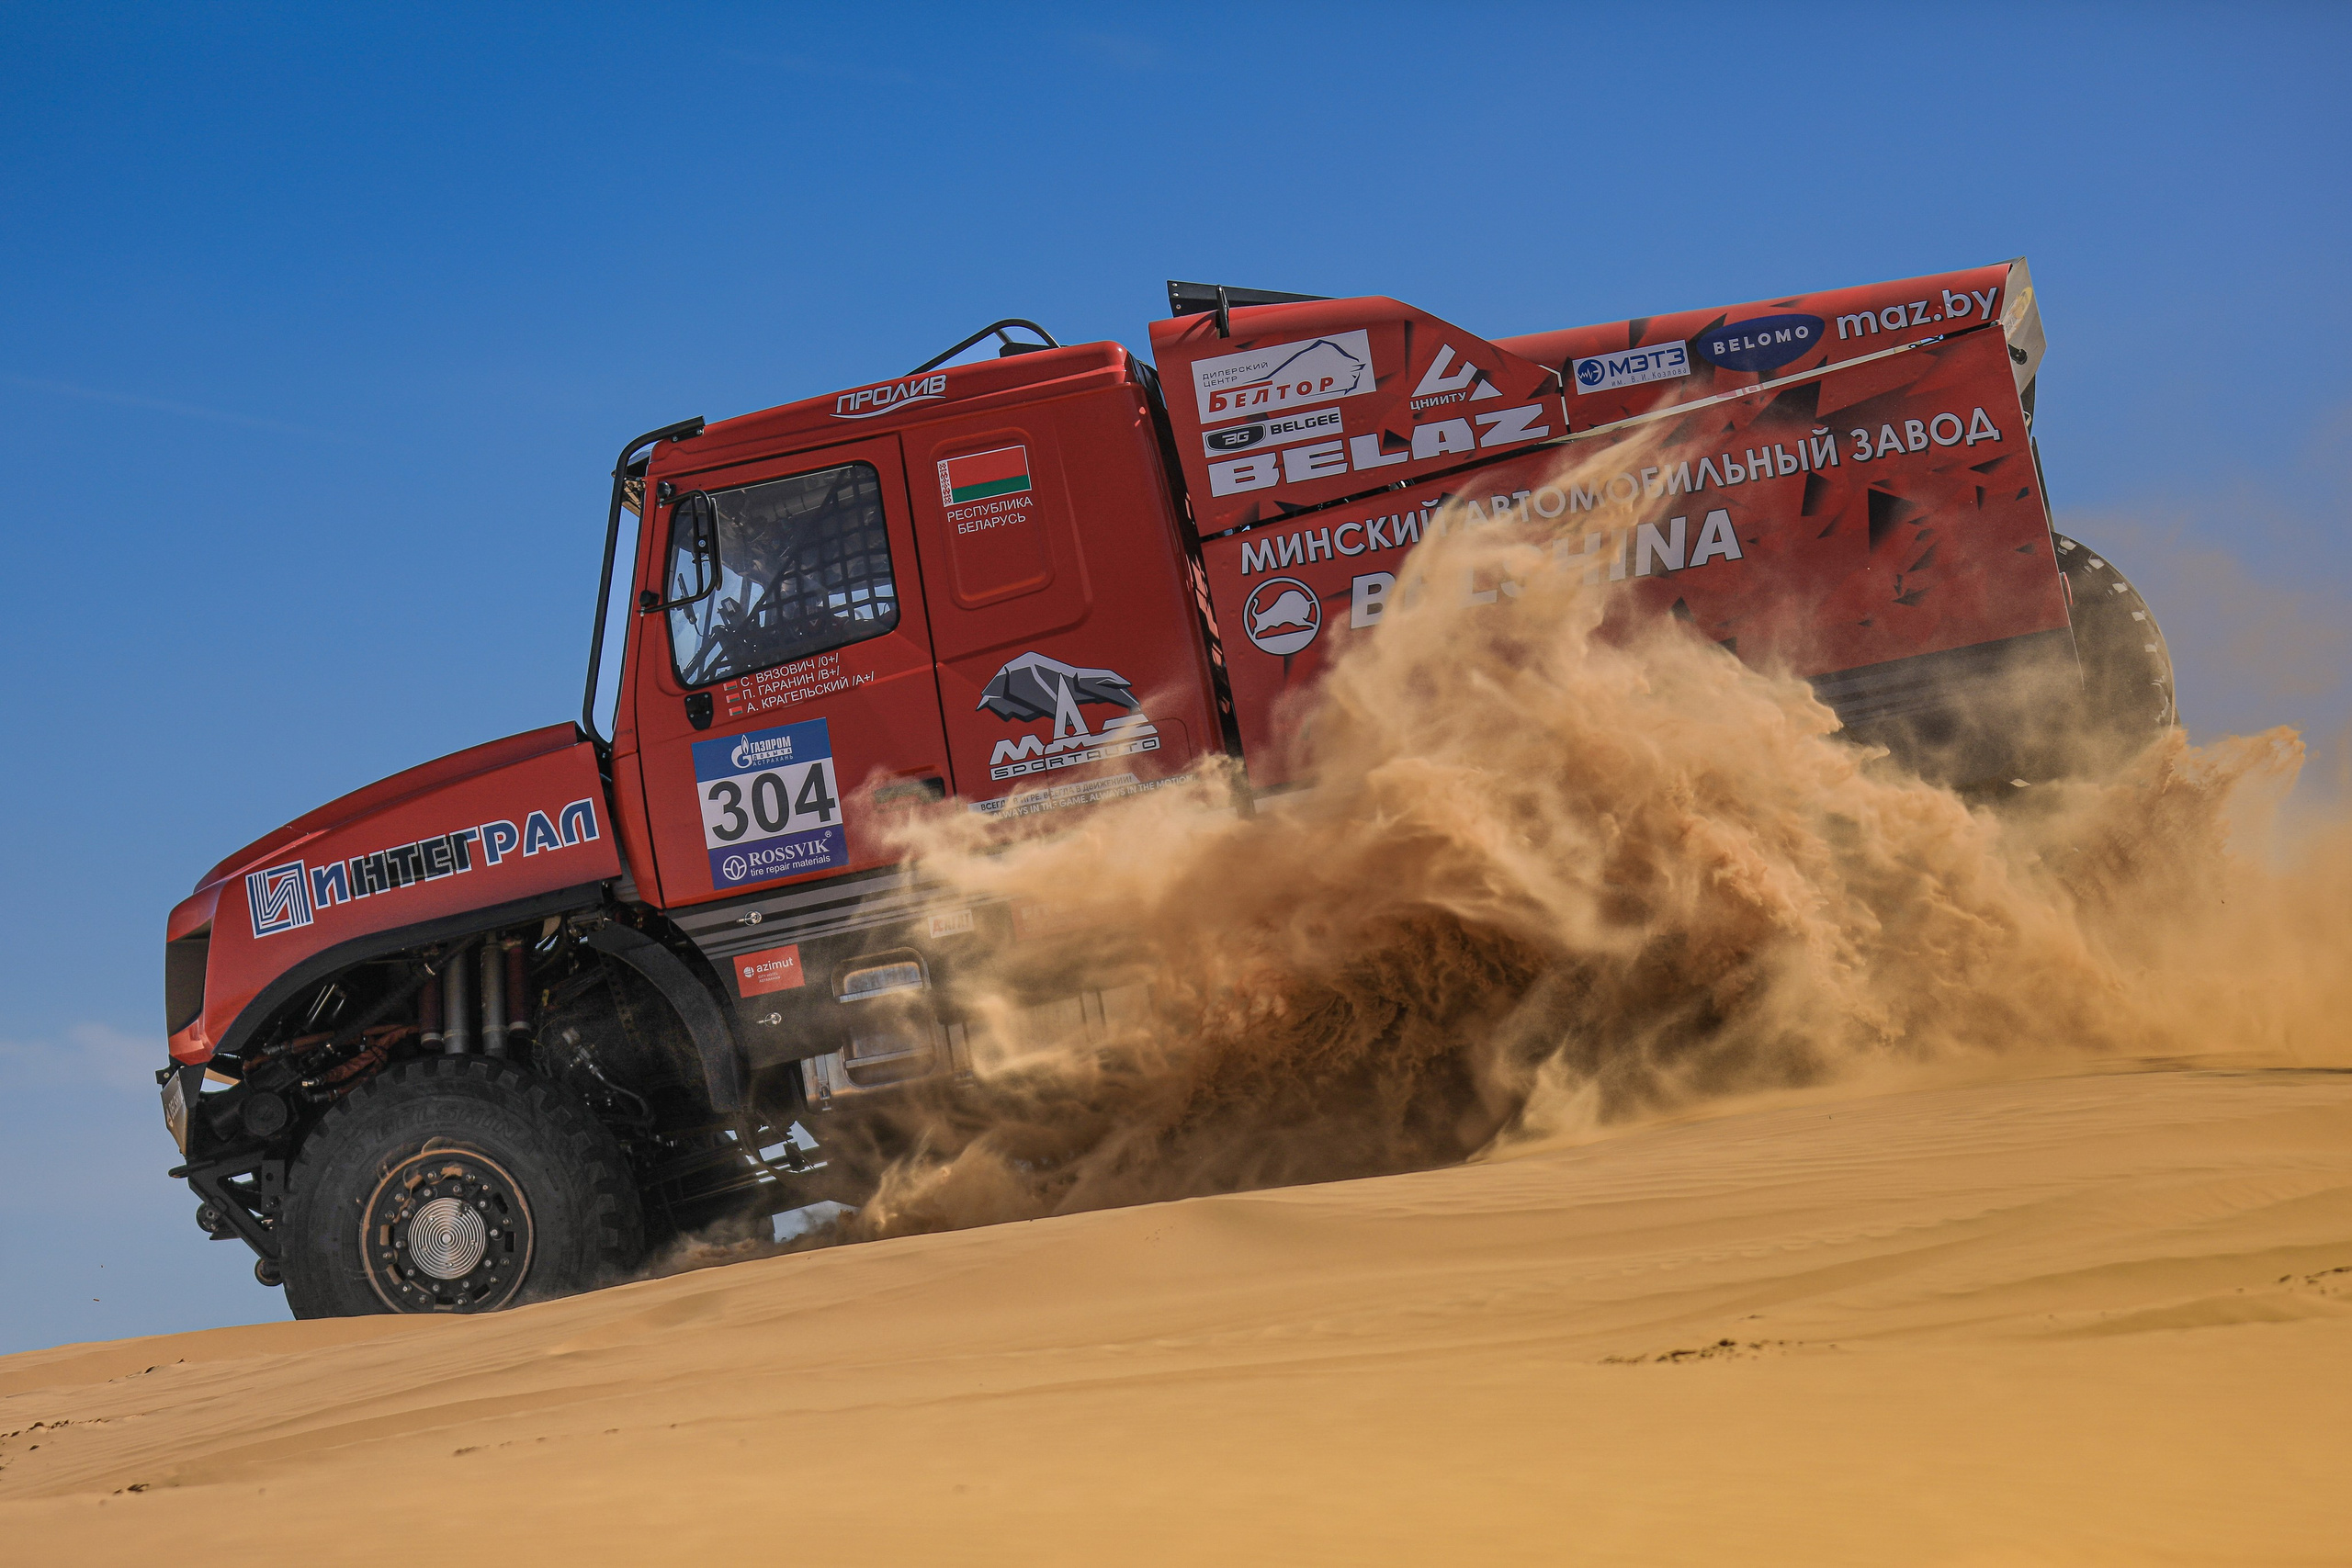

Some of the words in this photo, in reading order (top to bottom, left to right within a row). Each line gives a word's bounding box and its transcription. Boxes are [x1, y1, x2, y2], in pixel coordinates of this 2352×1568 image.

[1837, 287, 1998, 341] maz.by
[1713, 325, 1809, 355] BELOMO
[1203, 362, 1269, 380] ДИЛЕРСКИЙ
[1609, 347, 1685, 377] МЭТЗ
[837, 375, 946, 413] ПРОЛИВ
[1204, 376, 1238, 388] ЦЕНТР
[1409, 391, 1466, 412] ЦНИИТУ
[1270, 412, 1340, 434] BELGEE
[1207, 403, 1550, 498] BELAZ
[1241, 499, 1447, 576] МИНСКИЙ
[1464, 426, 1838, 532] АВТОМОБИЛЬНЫЙ
[1851, 407, 2002, 462] ЗАВОД
[947, 496, 1034, 523] РЕСПУБЛИКА
[957, 512, 1026, 535] БЕЛАРУСЬ
[1351, 508, 1743, 629] BLHINA
[755, 659, 815, 683] ВЯЗОВИЧ
[742, 689, 756, 700] П.
[758, 672, 815, 695] ГАРАНИН
[762, 678, 849, 709] КРАГЕЛЬСКИЙ
[751, 736, 791, 753] ГАЗПРОМ
[752, 748, 792, 761] ДОБЫЧА
[753, 755, 794, 766] АСТРАХАНЬ
[994, 739, 1158, 779] SPORTAUTO
[707, 762, 836, 841] 304
[980, 798, 1007, 811] ВСЕГД
[1030, 805, 1040, 814] IN
[1059, 795, 1089, 807] GAME.
[1090, 787, 1125, 802] ALWAYS
[1127, 785, 1137, 795] IN
[1138, 782, 1155, 792] THE
[751, 868, 764, 876] tire
[766, 863, 790, 874] repair
[793, 855, 831, 868] materials
[756, 956, 794, 973] azimut
